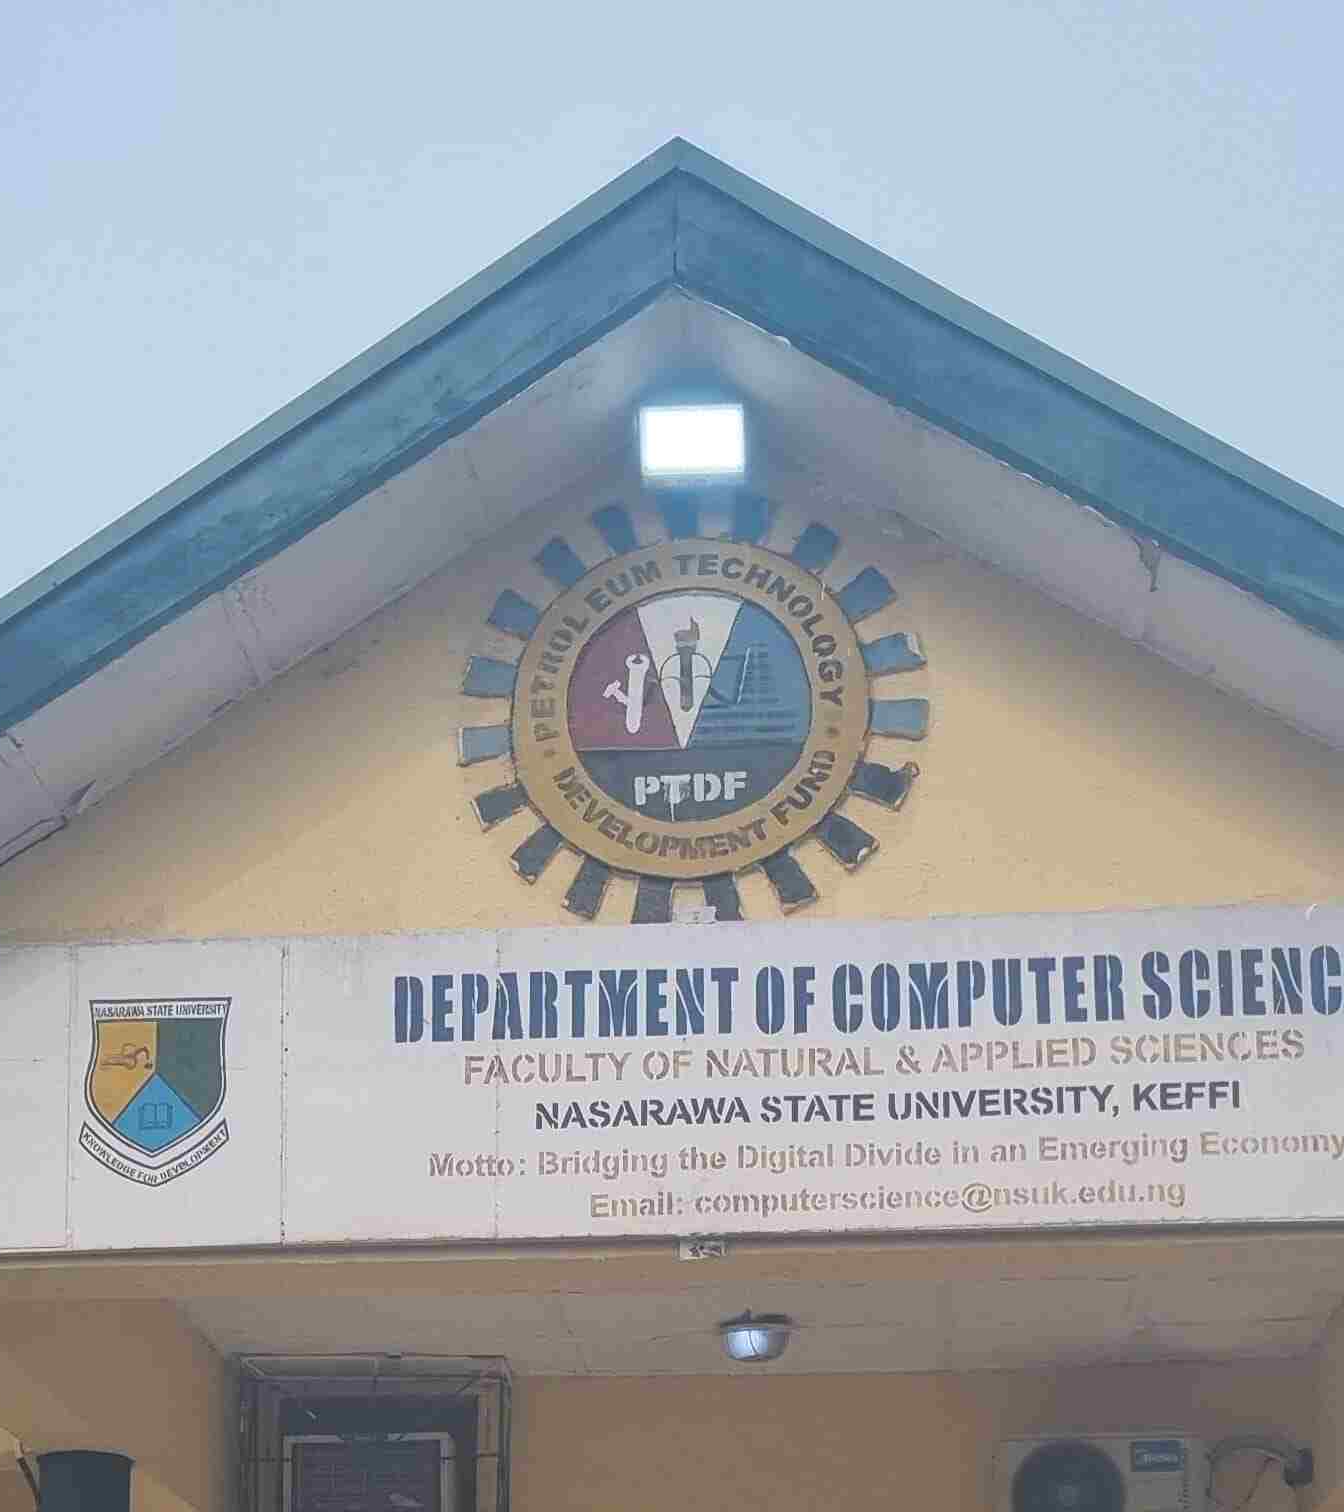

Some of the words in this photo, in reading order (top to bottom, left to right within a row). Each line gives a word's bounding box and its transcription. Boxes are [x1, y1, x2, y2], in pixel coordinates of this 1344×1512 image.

[534, 560, 662, 742] PETROLEUM
[673, 552, 845, 707] TECHNOLOGY
[552, 767, 769, 861] DEVELOPMENT
[769, 749, 837, 825] FUND
[633, 770, 748, 806] PTDF
[94, 1004, 144, 1018] NASARAWA
[146, 1004, 174, 1016] STATE
[175, 1003, 226, 1016] UNIVERSITY
[393, 966, 739, 1043] DEPARTMENT
[755, 965, 817, 1036] OF
[831, 954, 1126, 1035] COMPUTER
[463, 1051, 633, 1085] FACULTY
[641, 1049, 693, 1081] OF
[705, 1047, 885, 1079] NATURAL
[895, 1044, 922, 1075] &
[932, 1036, 1097, 1073] APPLIED
[1109, 1028, 1306, 1066] SCIENCES
[535, 1095, 751, 1130] NASARAWA
[760, 1093, 875, 1123] STATE
[887, 1084, 1120, 1121] UNIVERSITY,
[1132, 1080, 1241, 1111] KEFFI
[428, 1151, 526, 1178] Motto:
[538, 1148, 668, 1180] Bridging
[678, 1146, 727, 1170] the
[738, 1143, 833, 1175] Digital
[845, 1140, 941, 1169] Divide
[951, 1140, 981, 1165] in
[990, 1144, 1027, 1163] an
[1038, 1135, 1189, 1164] Emerging
[590, 1193, 683, 1218] Email:
[695, 1180, 1186, 1217] computerscience@nsuk.edu.ng
